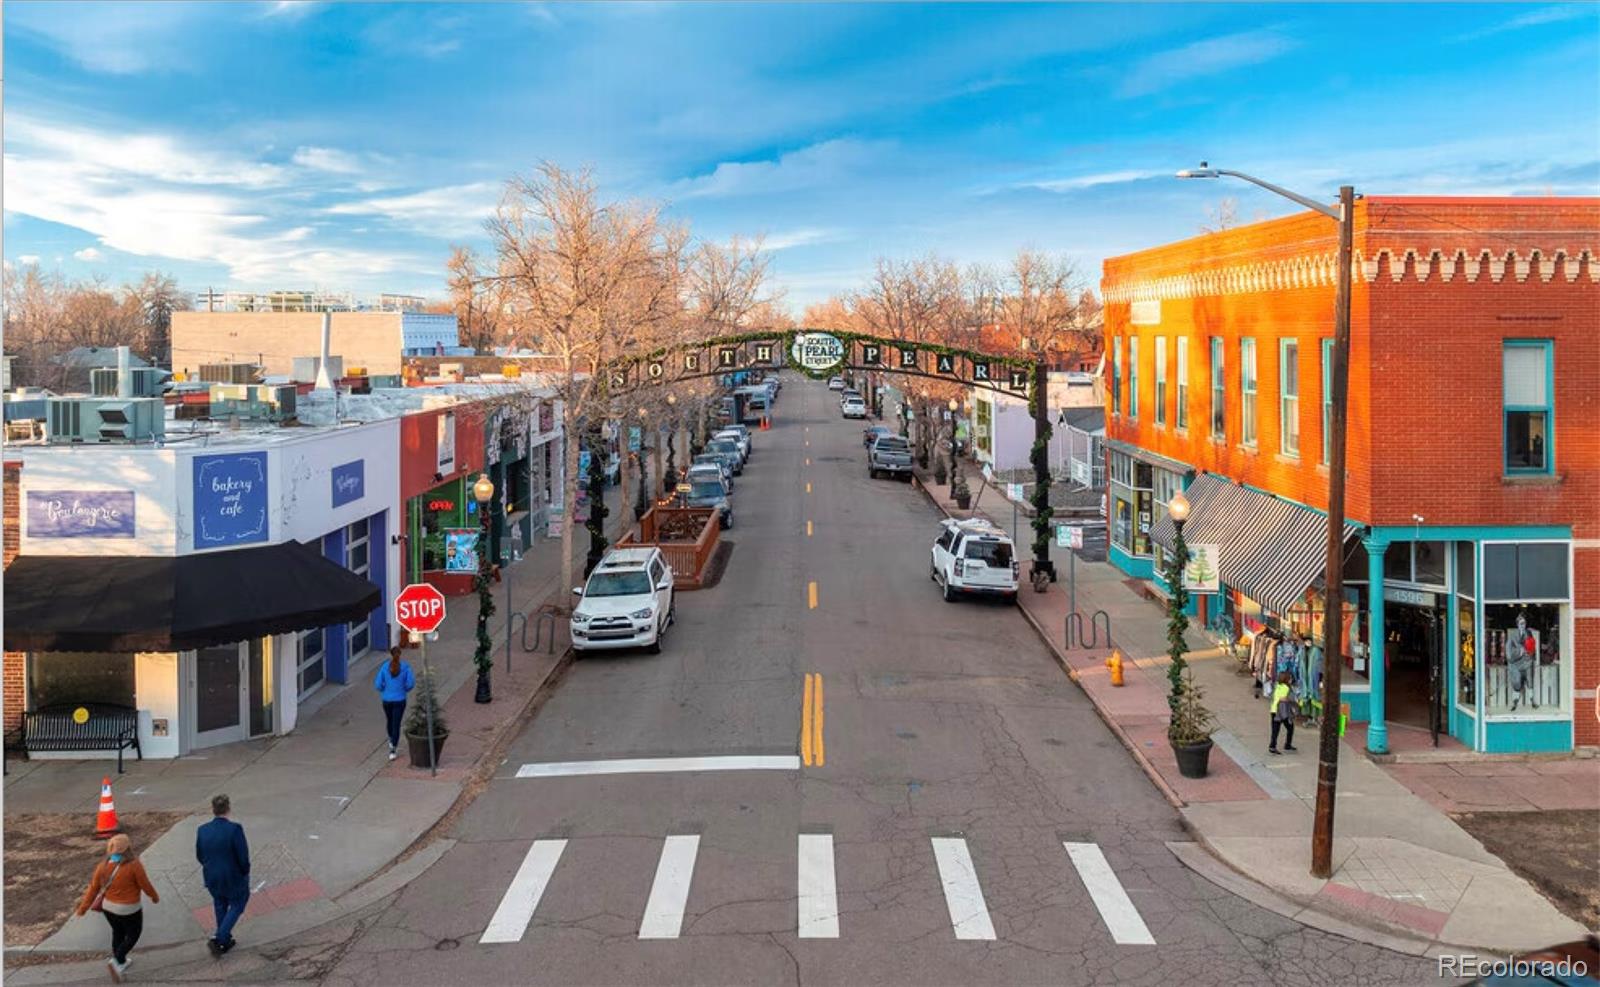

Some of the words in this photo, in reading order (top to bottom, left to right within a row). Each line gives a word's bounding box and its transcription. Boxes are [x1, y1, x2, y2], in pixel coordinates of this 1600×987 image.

[807, 337, 836, 345] SOUTH
[806, 345, 843, 361] PEARL
[612, 346, 771, 386] SOUTH
[866, 347, 1025, 388] PEARL
[806, 357, 832, 365] STREET
[212, 476, 253, 494] bakery
[223, 491, 241, 502] and
[429, 501, 454, 511] OPEN
[400, 598, 441, 619] STOP
